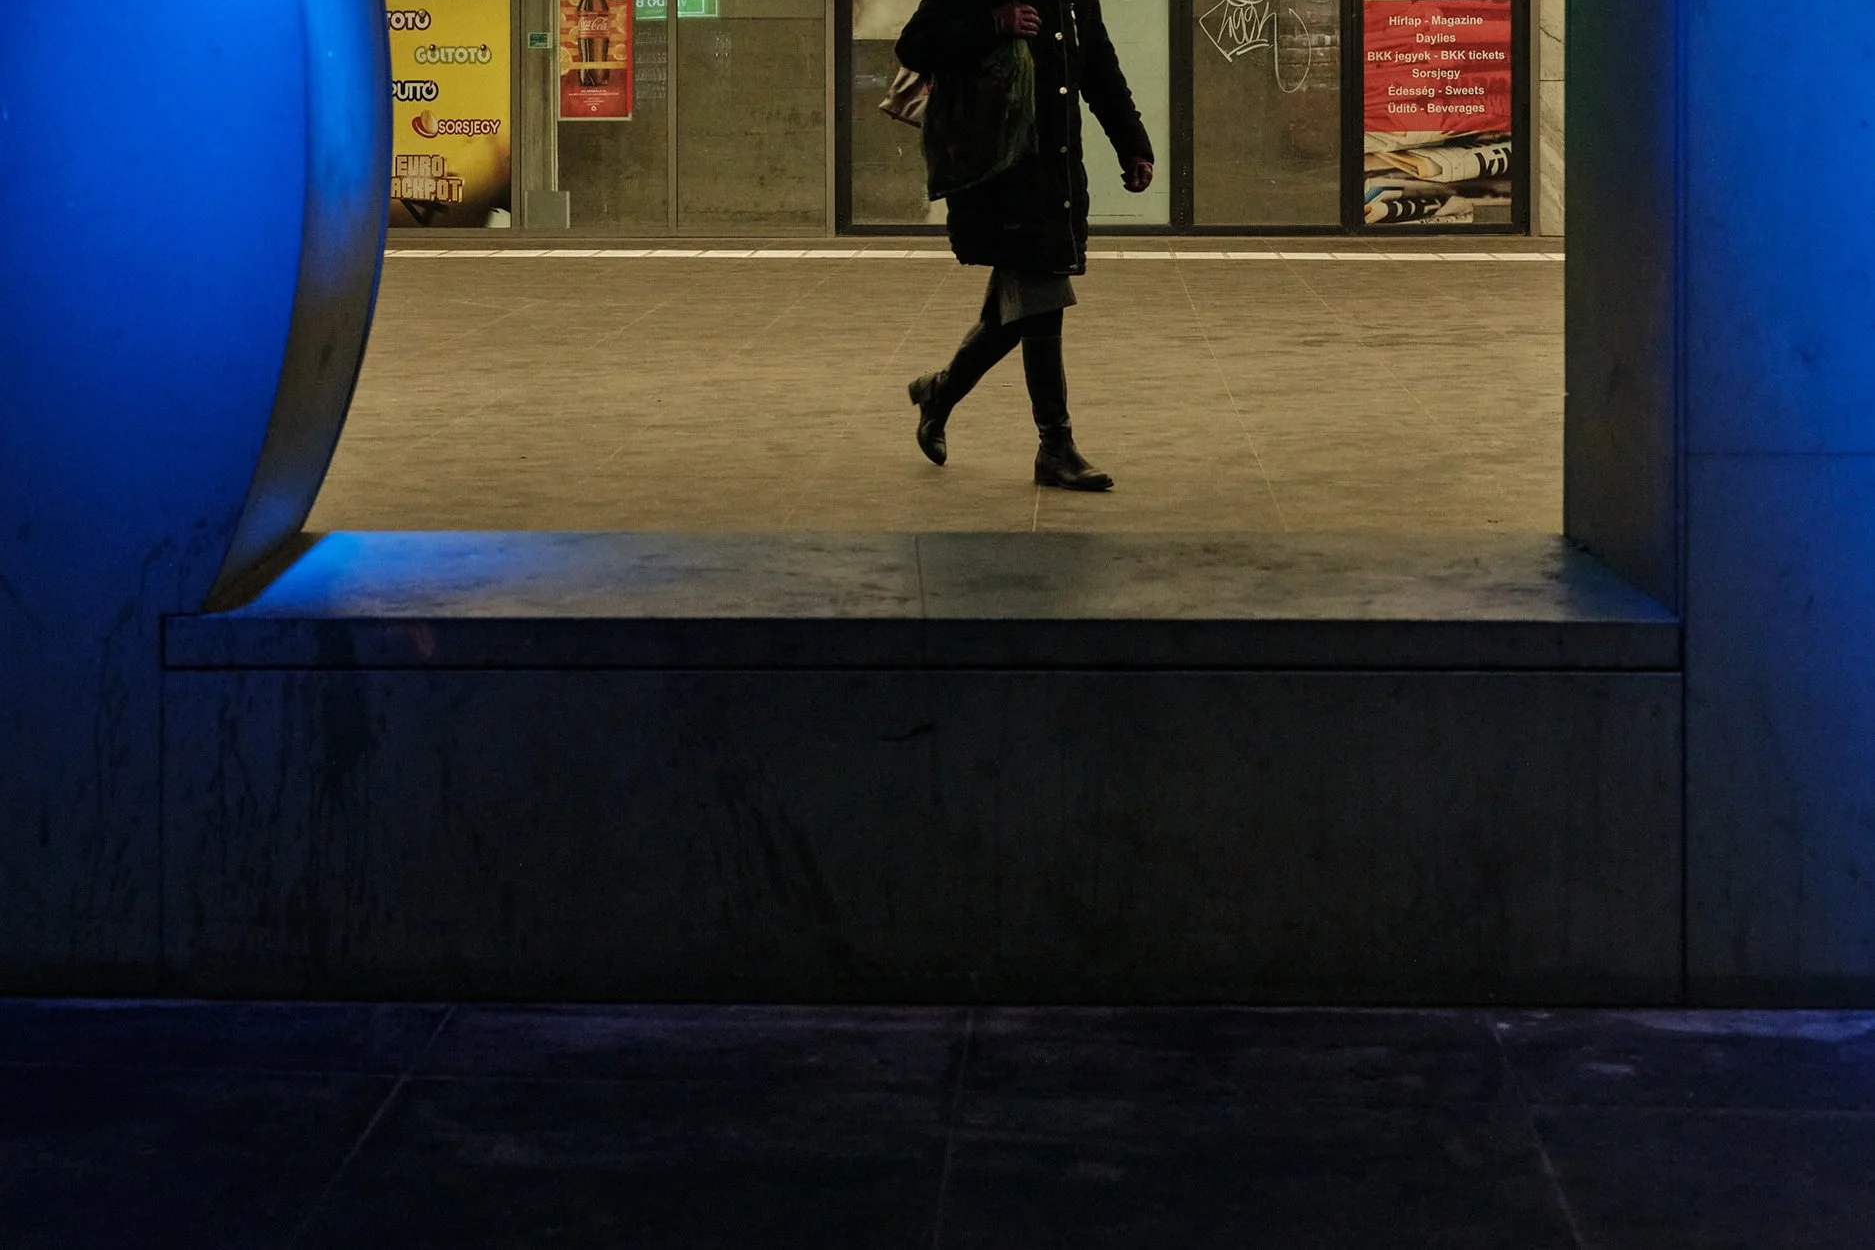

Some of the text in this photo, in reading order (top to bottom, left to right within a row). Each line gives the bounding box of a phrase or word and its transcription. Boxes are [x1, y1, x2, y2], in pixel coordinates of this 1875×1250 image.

[1389, 15, 1422, 28] Hírlap
[1431, 14, 1483, 27] Magazine
[1416, 33, 1456, 45] Daylies
[1367, 51, 1393, 61] BKK
[1395, 51, 1431, 63] jegyek
[1441, 50, 1466, 60] BKK
[1468, 49, 1505, 60] tickets
[1412, 68, 1460, 80] Sorsjegy
[1388, 85, 1435, 97] Édesség
[1445, 85, 1485, 95] Sweets
[1427, 103, 1485, 115] Beverages
[437, 119, 501, 137] SORSJEGY
[395, 155, 446, 177] EURO
